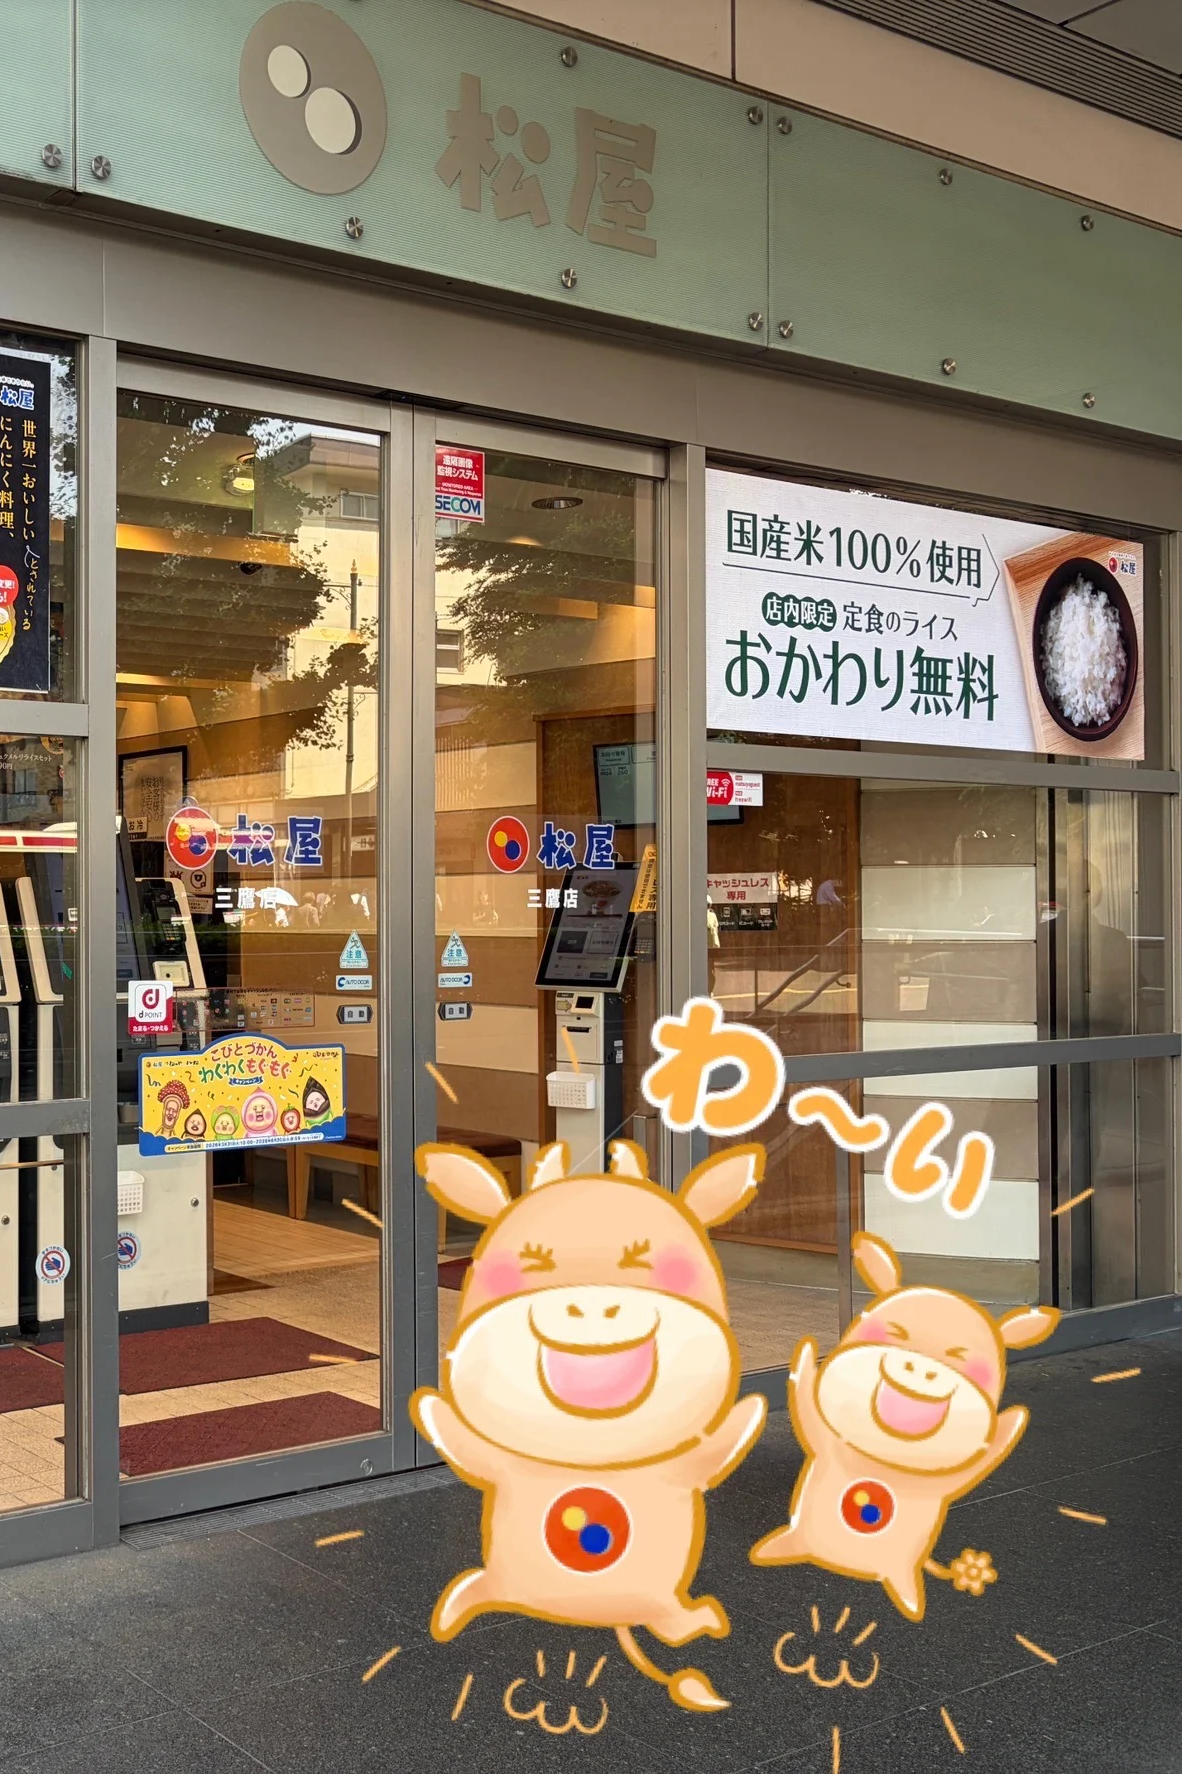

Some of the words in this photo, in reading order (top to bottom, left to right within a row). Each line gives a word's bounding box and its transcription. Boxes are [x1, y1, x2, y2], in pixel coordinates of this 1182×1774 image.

[435, 72, 657, 258] 松屋
[0, 386, 34, 410] 松屋
[22, 420, 37, 540] 世界一おいしい
[435, 495, 480, 515] SECOM
[726, 509, 982, 589] 国産米100%使用
[23, 558, 39, 630] とされている
[765, 595, 836, 628] 店内限定
[842, 601, 958, 642] 定食のライス
[725, 630, 999, 721] おかわり無料
[707, 778, 719, 786] REE
[228, 813, 323, 867] 松屋
[537, 821, 615, 870] 松屋
[527, 888, 579, 909] 三鷹店
[727, 891, 746, 900] 専用
[347, 950, 361, 959] 注意
[448, 949, 462, 957] 注意
[211, 1041, 277, 1062] こびとづかん
[199, 1058, 292, 1083] わくわくもぐもぐ
